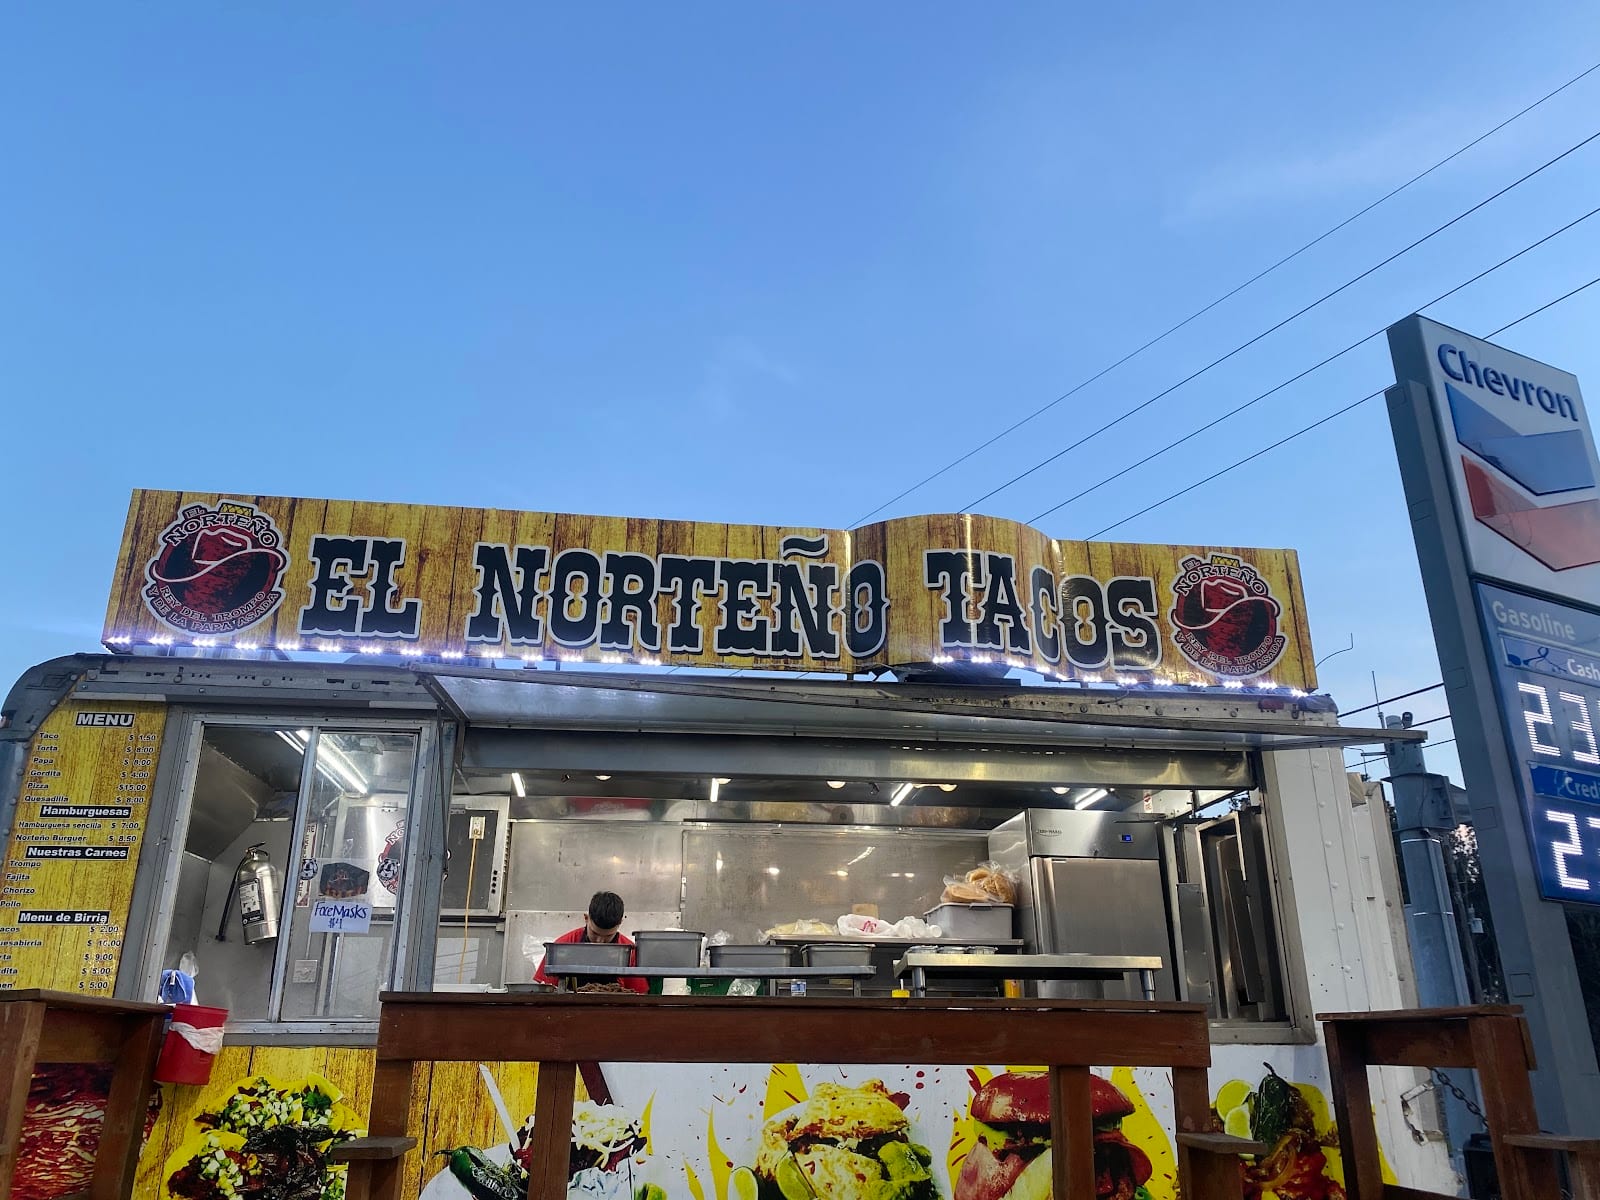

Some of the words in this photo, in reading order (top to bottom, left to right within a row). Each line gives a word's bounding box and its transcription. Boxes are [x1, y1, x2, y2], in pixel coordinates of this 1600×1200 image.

[1437, 343, 1579, 422] Chevron
[185, 506, 205, 519] EL
[164, 512, 277, 547] NORTEÑO
[1175, 564, 1267, 597] NORTEÑO
[148, 586, 160, 596] Y
[154, 597, 171, 616] DE
[169, 612, 187, 627] LA
[160, 585, 182, 608] REY
[180, 606, 208, 622] DEL
[212, 591, 266, 622] TROMPO
[299, 535, 421, 640] EL
[464, 534, 889, 659] NORTEÑO
[923, 548, 1162, 671] TACOS
[1492, 600, 1576, 641] Gasoline
[1185, 631, 1208, 654] REY
[1234, 635, 1273, 665] TROMPO
[1567, 658, 1600, 681] Cash
[77, 713, 133, 726] MENU
[1517, 681, 1600, 765] 23
[33, 757, 54, 765] Papa
[42, 806, 129, 817] Hamburguesas
[18, 821, 70, 829] Hamburguesa
[52, 834, 87, 843] Burguer
[27, 847, 82, 857] Nuestras
[85, 848, 127, 857] Carnes
[10, 860, 41, 868] Trompo
[6, 873, 30, 881] Fajita
[20, 912, 52, 922] Menu
[55, 913, 71, 922] de
[74, 913, 108, 923] Birria
[92, 967, 111, 975] 5.00
[89, 981, 108, 989] 5.00
